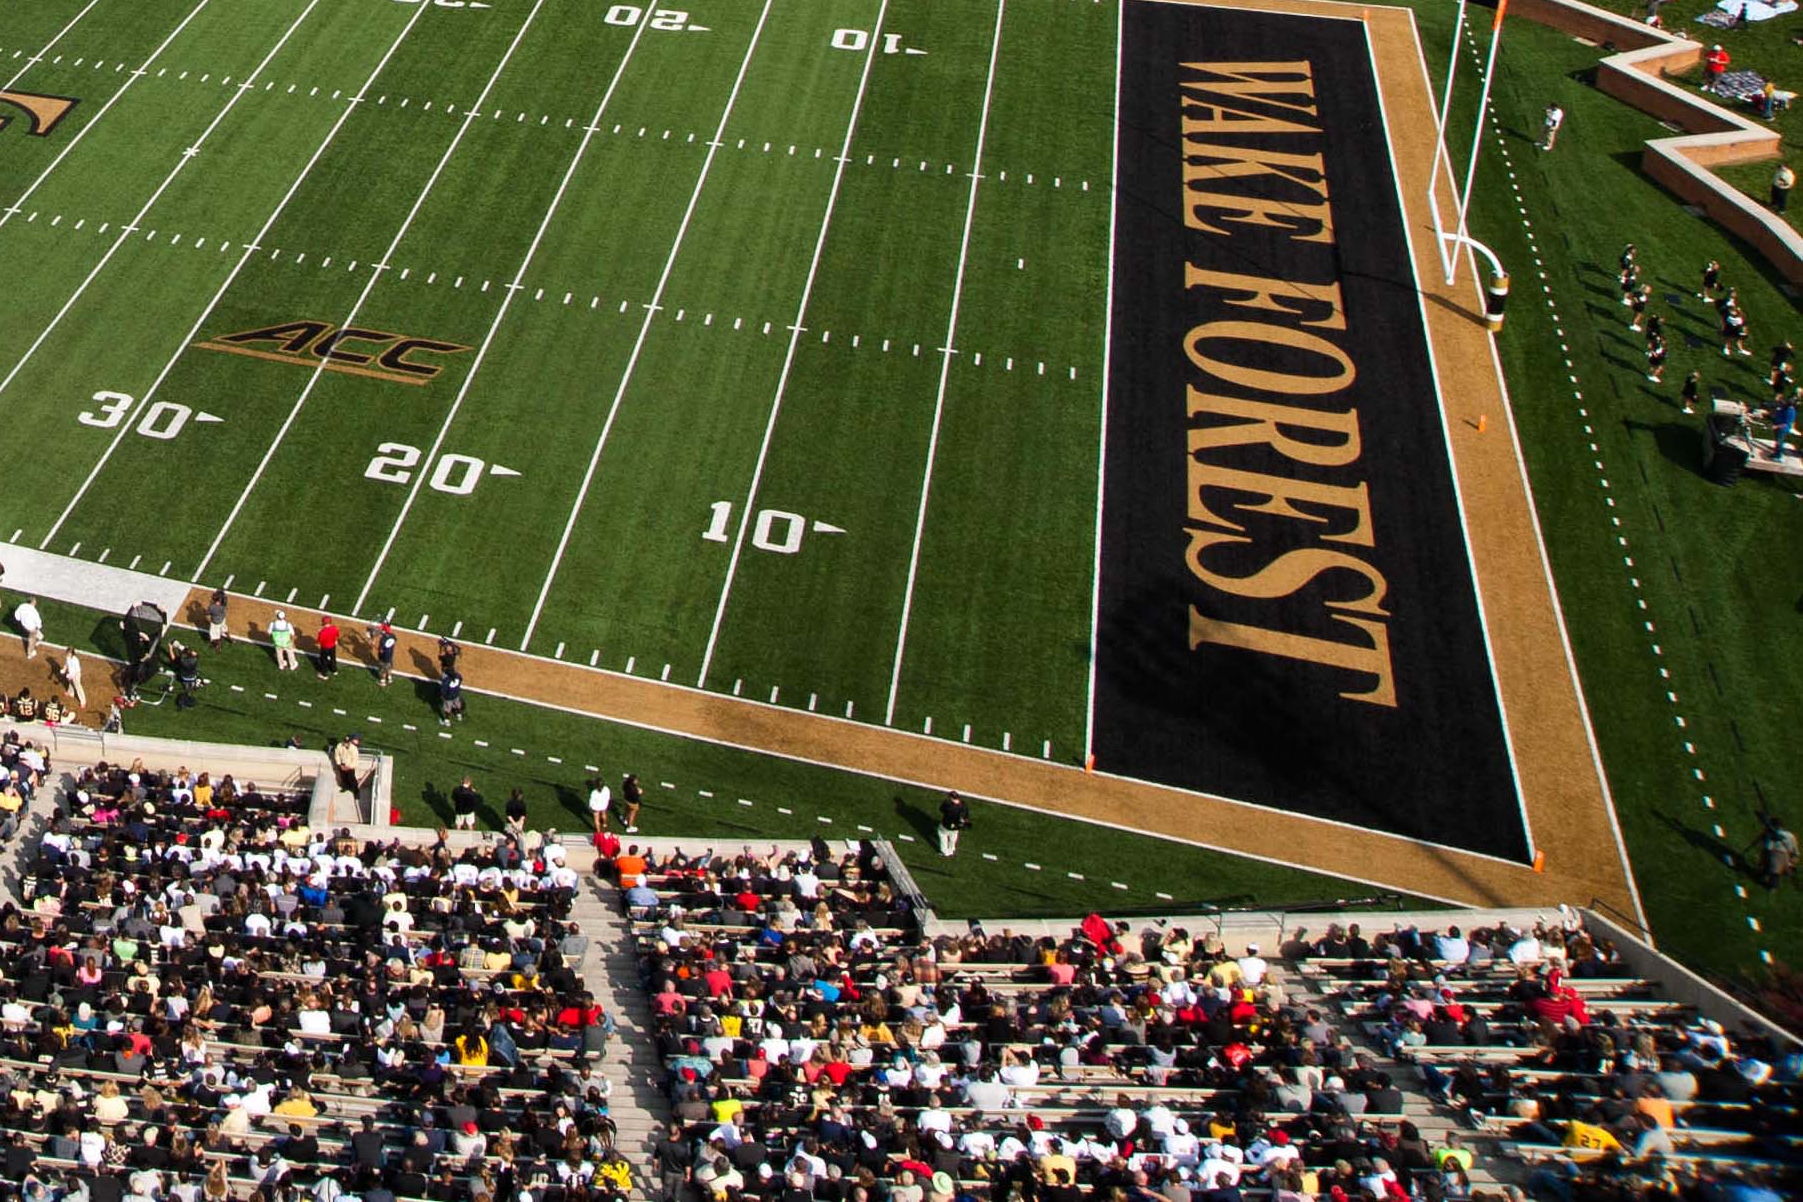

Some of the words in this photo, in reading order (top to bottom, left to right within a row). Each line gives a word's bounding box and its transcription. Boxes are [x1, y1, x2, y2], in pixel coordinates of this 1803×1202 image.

[1177, 60, 1339, 246] WAKE
[212, 320, 475, 378] ACC
[77, 390, 193, 440] 30
[364, 442, 485, 495] 20
[1182, 260, 1399, 709] FOREST
[701, 500, 806, 554] 10
[1580, 1134, 1601, 1148] 27
